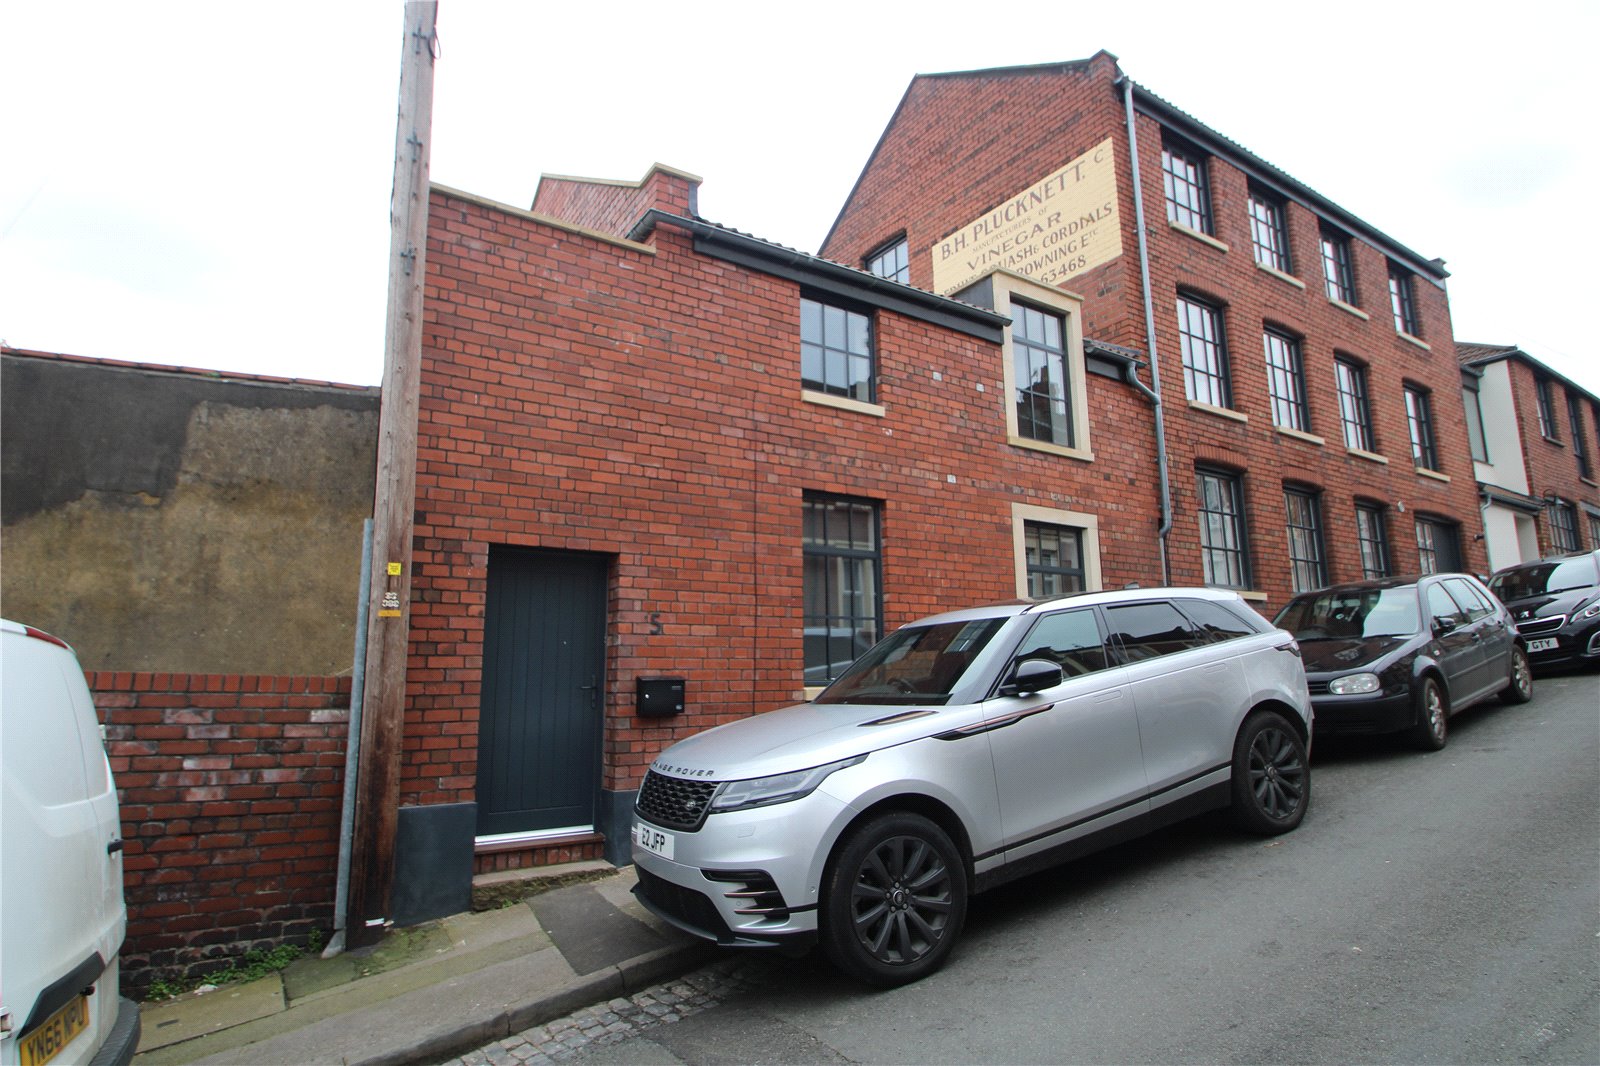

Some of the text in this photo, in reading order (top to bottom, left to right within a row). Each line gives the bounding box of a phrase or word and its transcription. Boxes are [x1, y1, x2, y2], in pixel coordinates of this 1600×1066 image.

[1042, 202, 1112, 250] CORDIALS
[967, 212, 1062, 270] VINEGAR
[650, 611, 662, 635] 5
[1532, 640, 1550, 649] GTY
[675, 767, 714, 777] ROVER
[642, 827, 666, 852] E2 JFP
